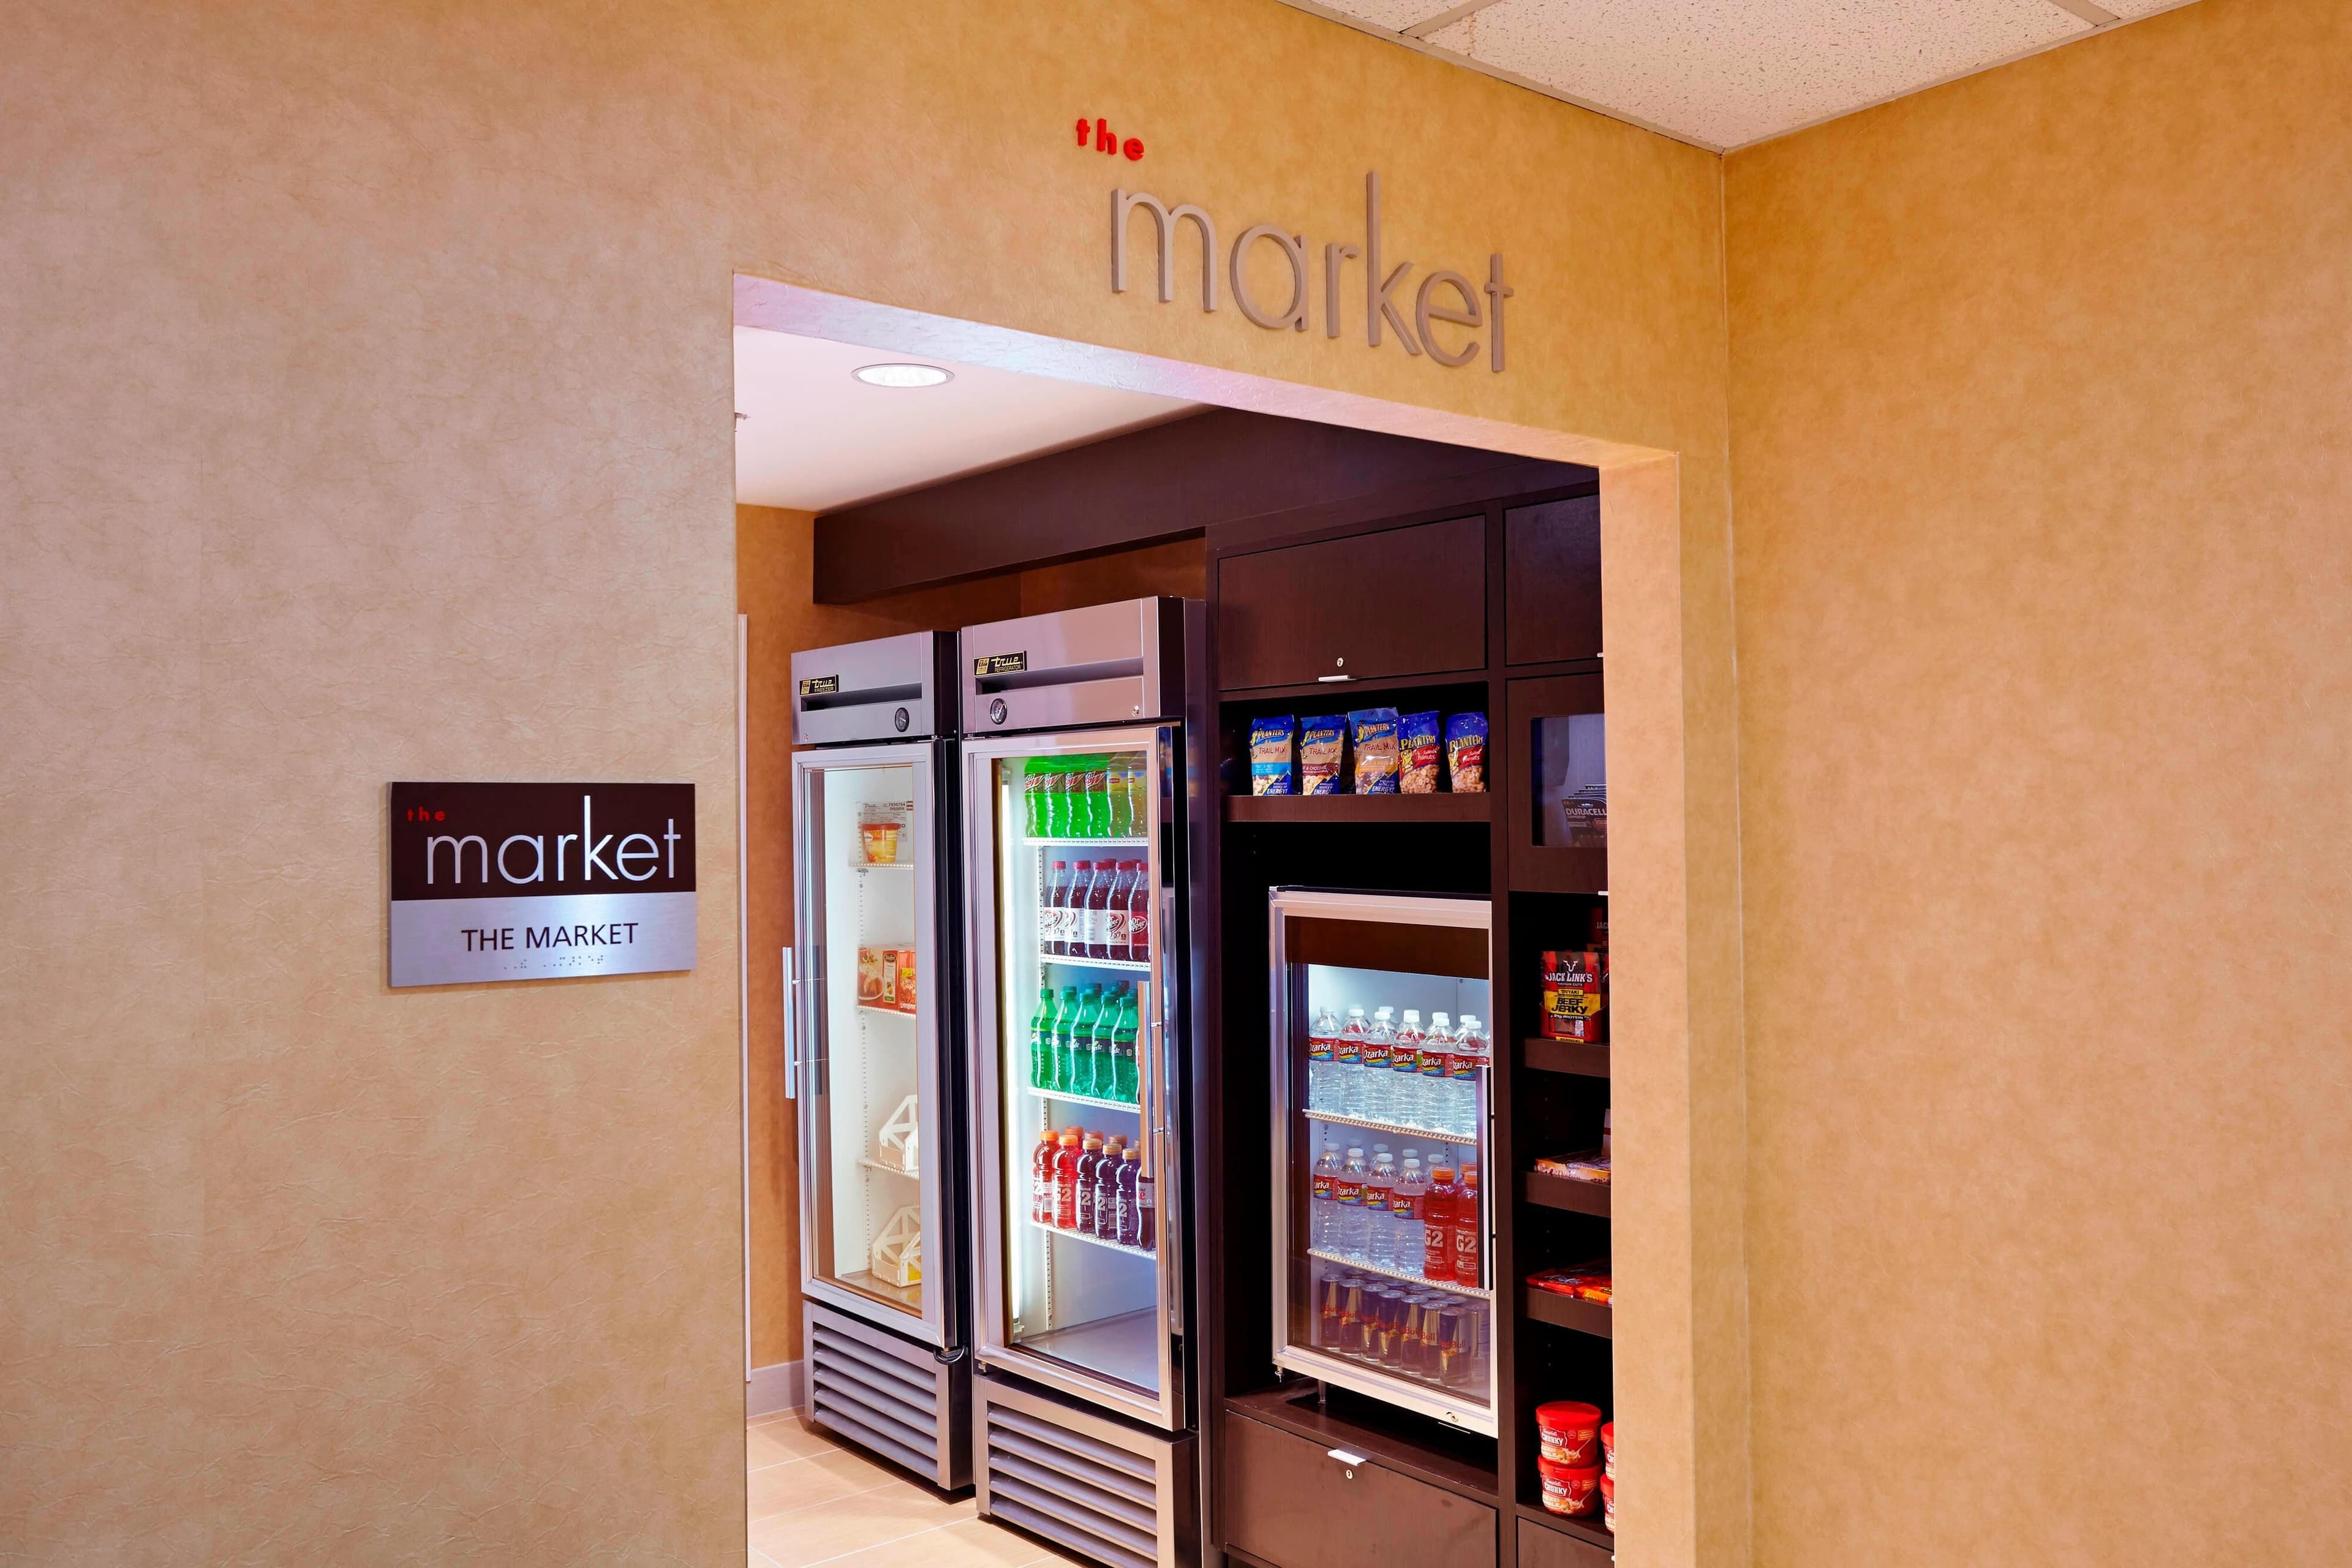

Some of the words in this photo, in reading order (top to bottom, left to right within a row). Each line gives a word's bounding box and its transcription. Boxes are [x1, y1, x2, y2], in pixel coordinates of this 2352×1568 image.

[1076, 118, 1145, 160] the
[1110, 171, 1515, 373] market
[990, 657, 1021, 667] true
[995, 664, 1021, 673] REFRIGERATOR
[1258, 729, 1284, 738] PLANTERS
[1311, 729, 1335, 738] PLANTERS
[1401, 735, 1436, 750] PLANTERS
[1449, 736, 1483, 753] PLANTERS
[407, 806, 446, 822] the
[427, 795, 681, 884] market
[461, 927, 514, 952] THE
[526, 922, 638, 948] MARKET
[1548, 973, 1566, 981] JACK
[1566, 972, 1593, 982] LINK'S
[1557, 997, 1583, 1006] BEEF
[1551, 1005, 1588, 1014] JERKY
[1339, 1046, 1359, 1054] zarka
[1422, 1057, 1441, 1066] zarka
[1453, 1060, 1472, 1070] zarka
[1366, 1192, 1384, 1200] zarka
[1393, 1199, 1411, 1208] zarka
[1425, 1229, 1443, 1248] G2
[1457, 1235, 1477, 1253] G2
[1542, 1432, 1563, 1446] CHUNKY
[1544, 1481, 1567, 1496] CHUNKY
